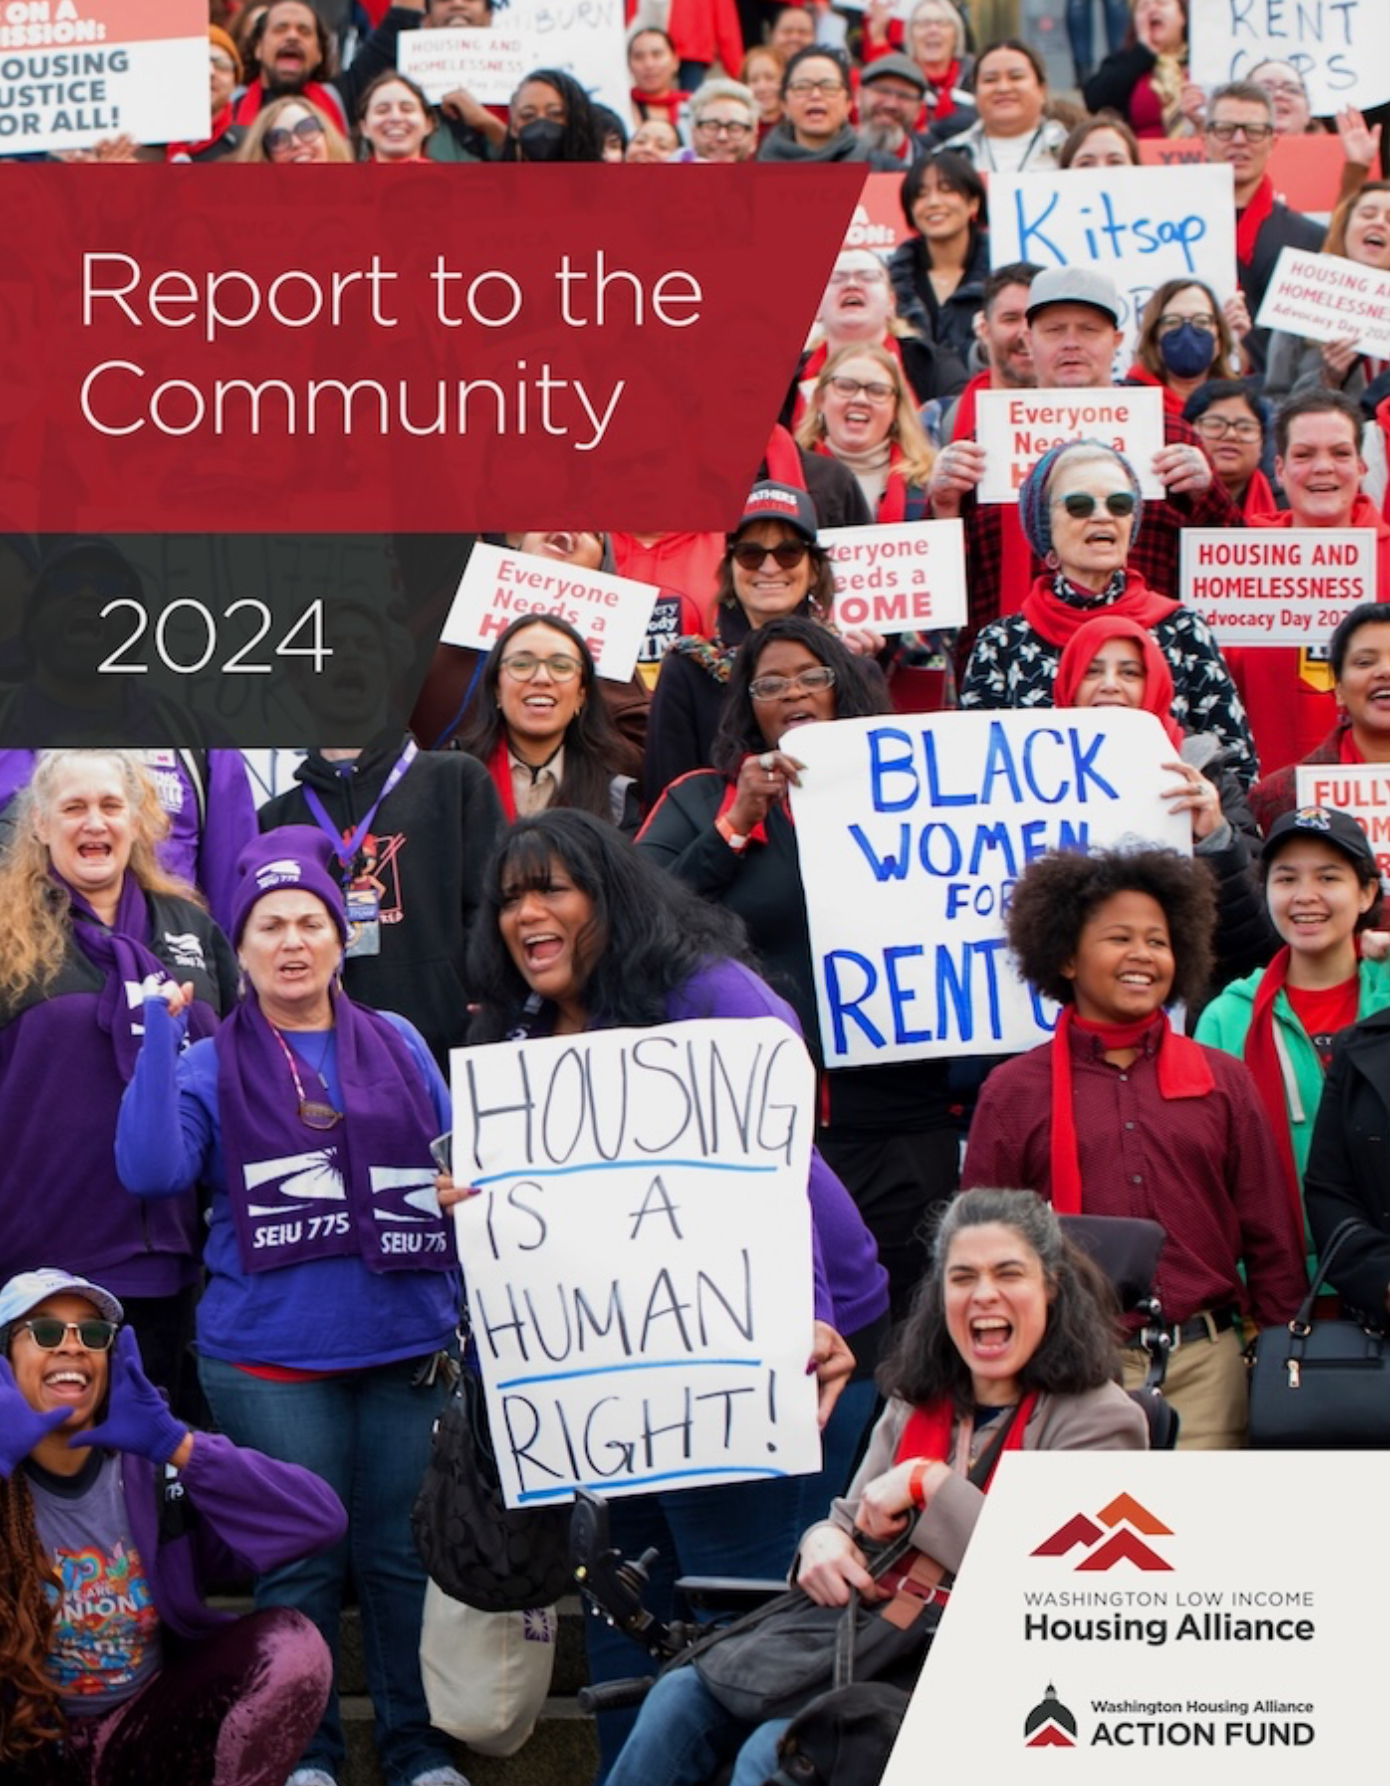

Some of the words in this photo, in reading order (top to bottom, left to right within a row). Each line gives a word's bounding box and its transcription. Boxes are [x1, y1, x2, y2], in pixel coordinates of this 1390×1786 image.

[5, 1, 49, 24] ON
[1231, 0, 1358, 45] RENT
[51, 106, 119, 133] ALL!
[1015, 188, 1206, 273] Kitsap
[1290, 261, 1368, 293] HOUSING
[1278, 282, 1390, 322] HOMELESSNE
[1010, 401, 1129, 430] Everyone
[1113, 436, 1126, 452] a
[747, 489, 797, 504] ATHERS
[1199, 544, 1302, 566] HOUSING
[1311, 544, 1360, 566] AND
[496, 559, 620, 608] Everyone
[834, 566, 898, 594] eeds
[911, 568, 926, 585] a
[1192, 577, 1364, 599] HOMELESSNESS
[591, 615, 607, 632] a
[830, 592, 932, 625] OME
[1203, 608, 1275, 631] dvocacy
[1280, 608, 1312, 631] Day
[867, 721, 1119, 813] BLACK
[824, 938, 1008, 1055] RENT
[466, 1037, 798, 1170] HOUSING
[253, 1221, 302, 1249] SEIU
[307, 1211, 350, 1240] 775
[486, 1180, 547, 1260] IS
[629, 1175, 684, 1240] A
[381, 1231, 422, 1253] SEIU
[476, 1249, 754, 1362] HUMAN
[503, 1369, 781, 1492] RIGHT!
